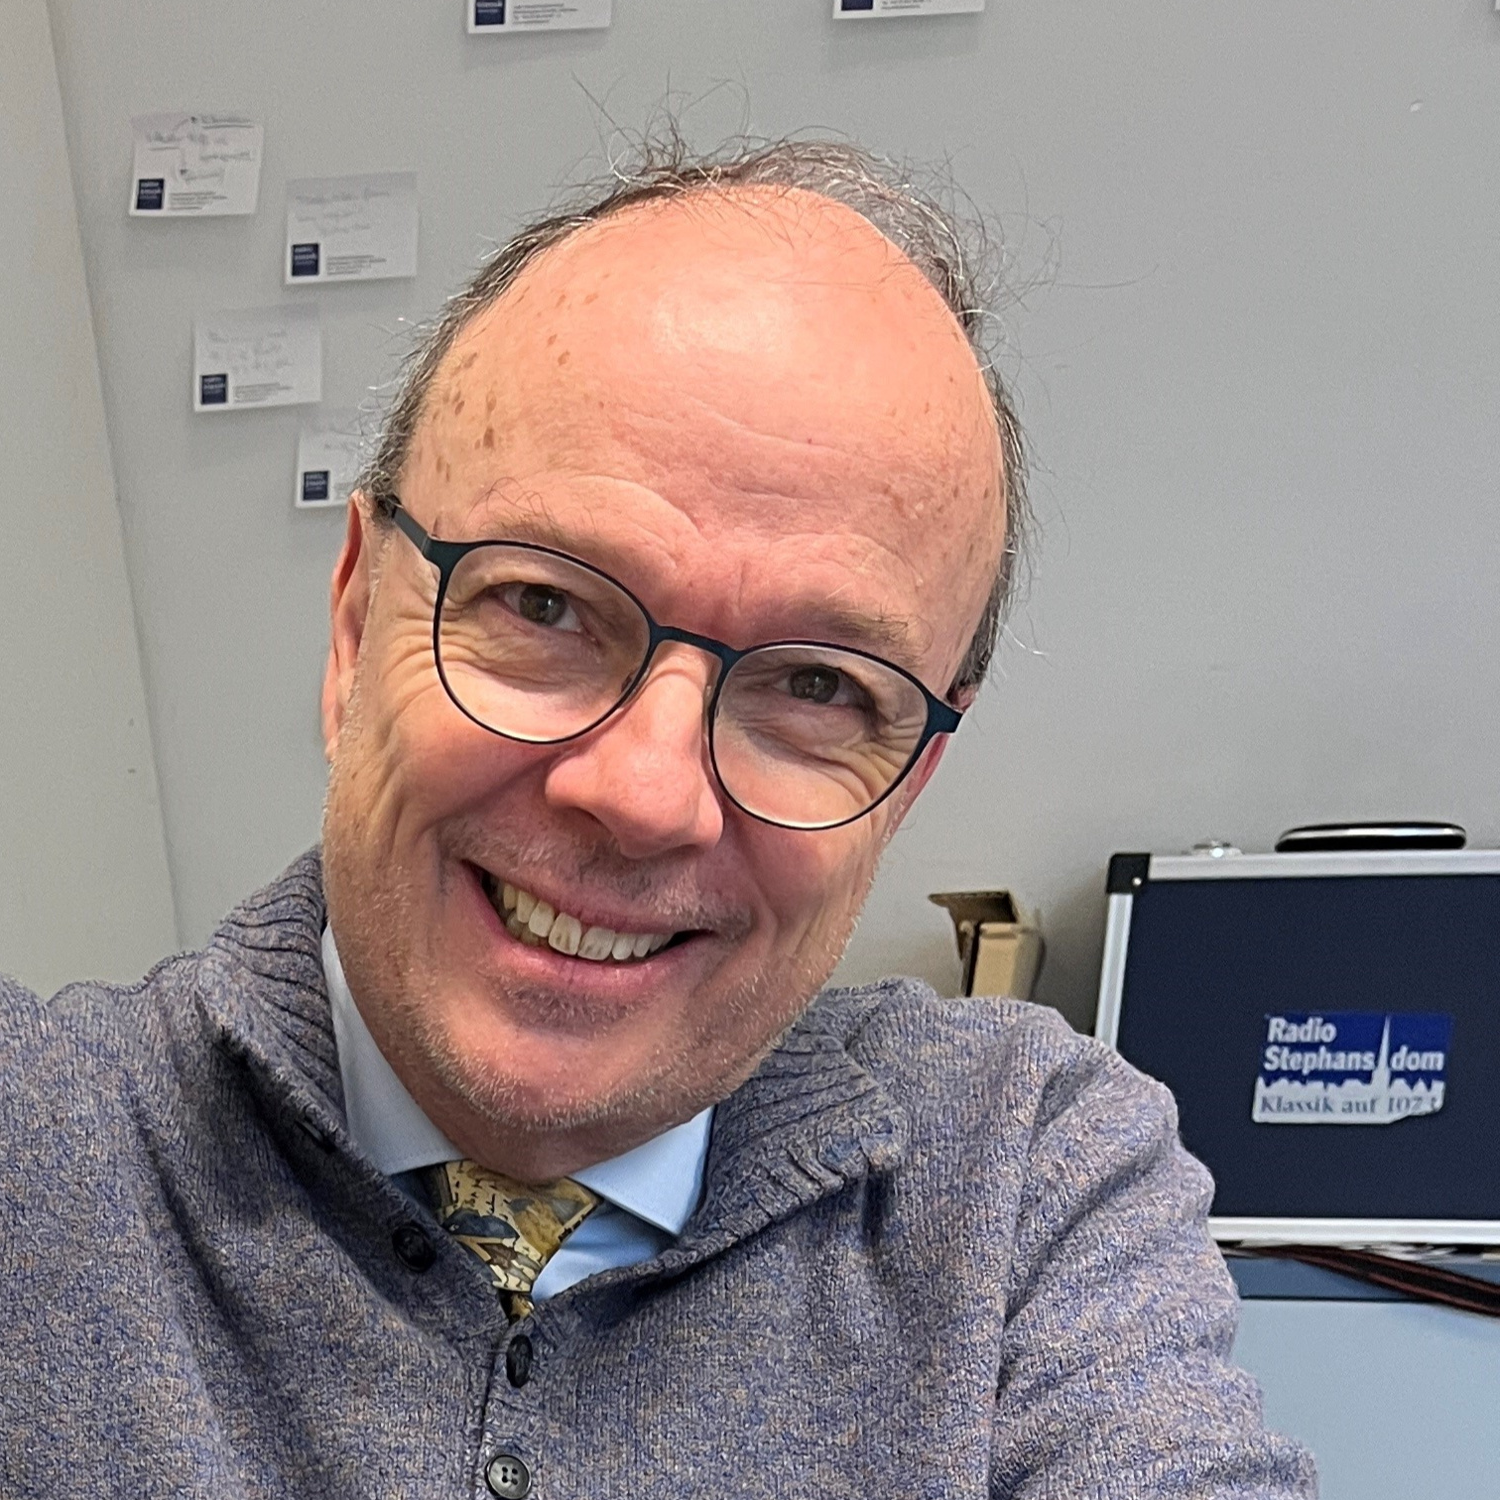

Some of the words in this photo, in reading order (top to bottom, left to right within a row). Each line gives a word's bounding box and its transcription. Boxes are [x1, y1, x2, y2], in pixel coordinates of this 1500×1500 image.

[1267, 1016, 1337, 1043] Radio
[1260, 1095, 1334, 1114] Klassik
[1341, 1096, 1377, 1114] auf
